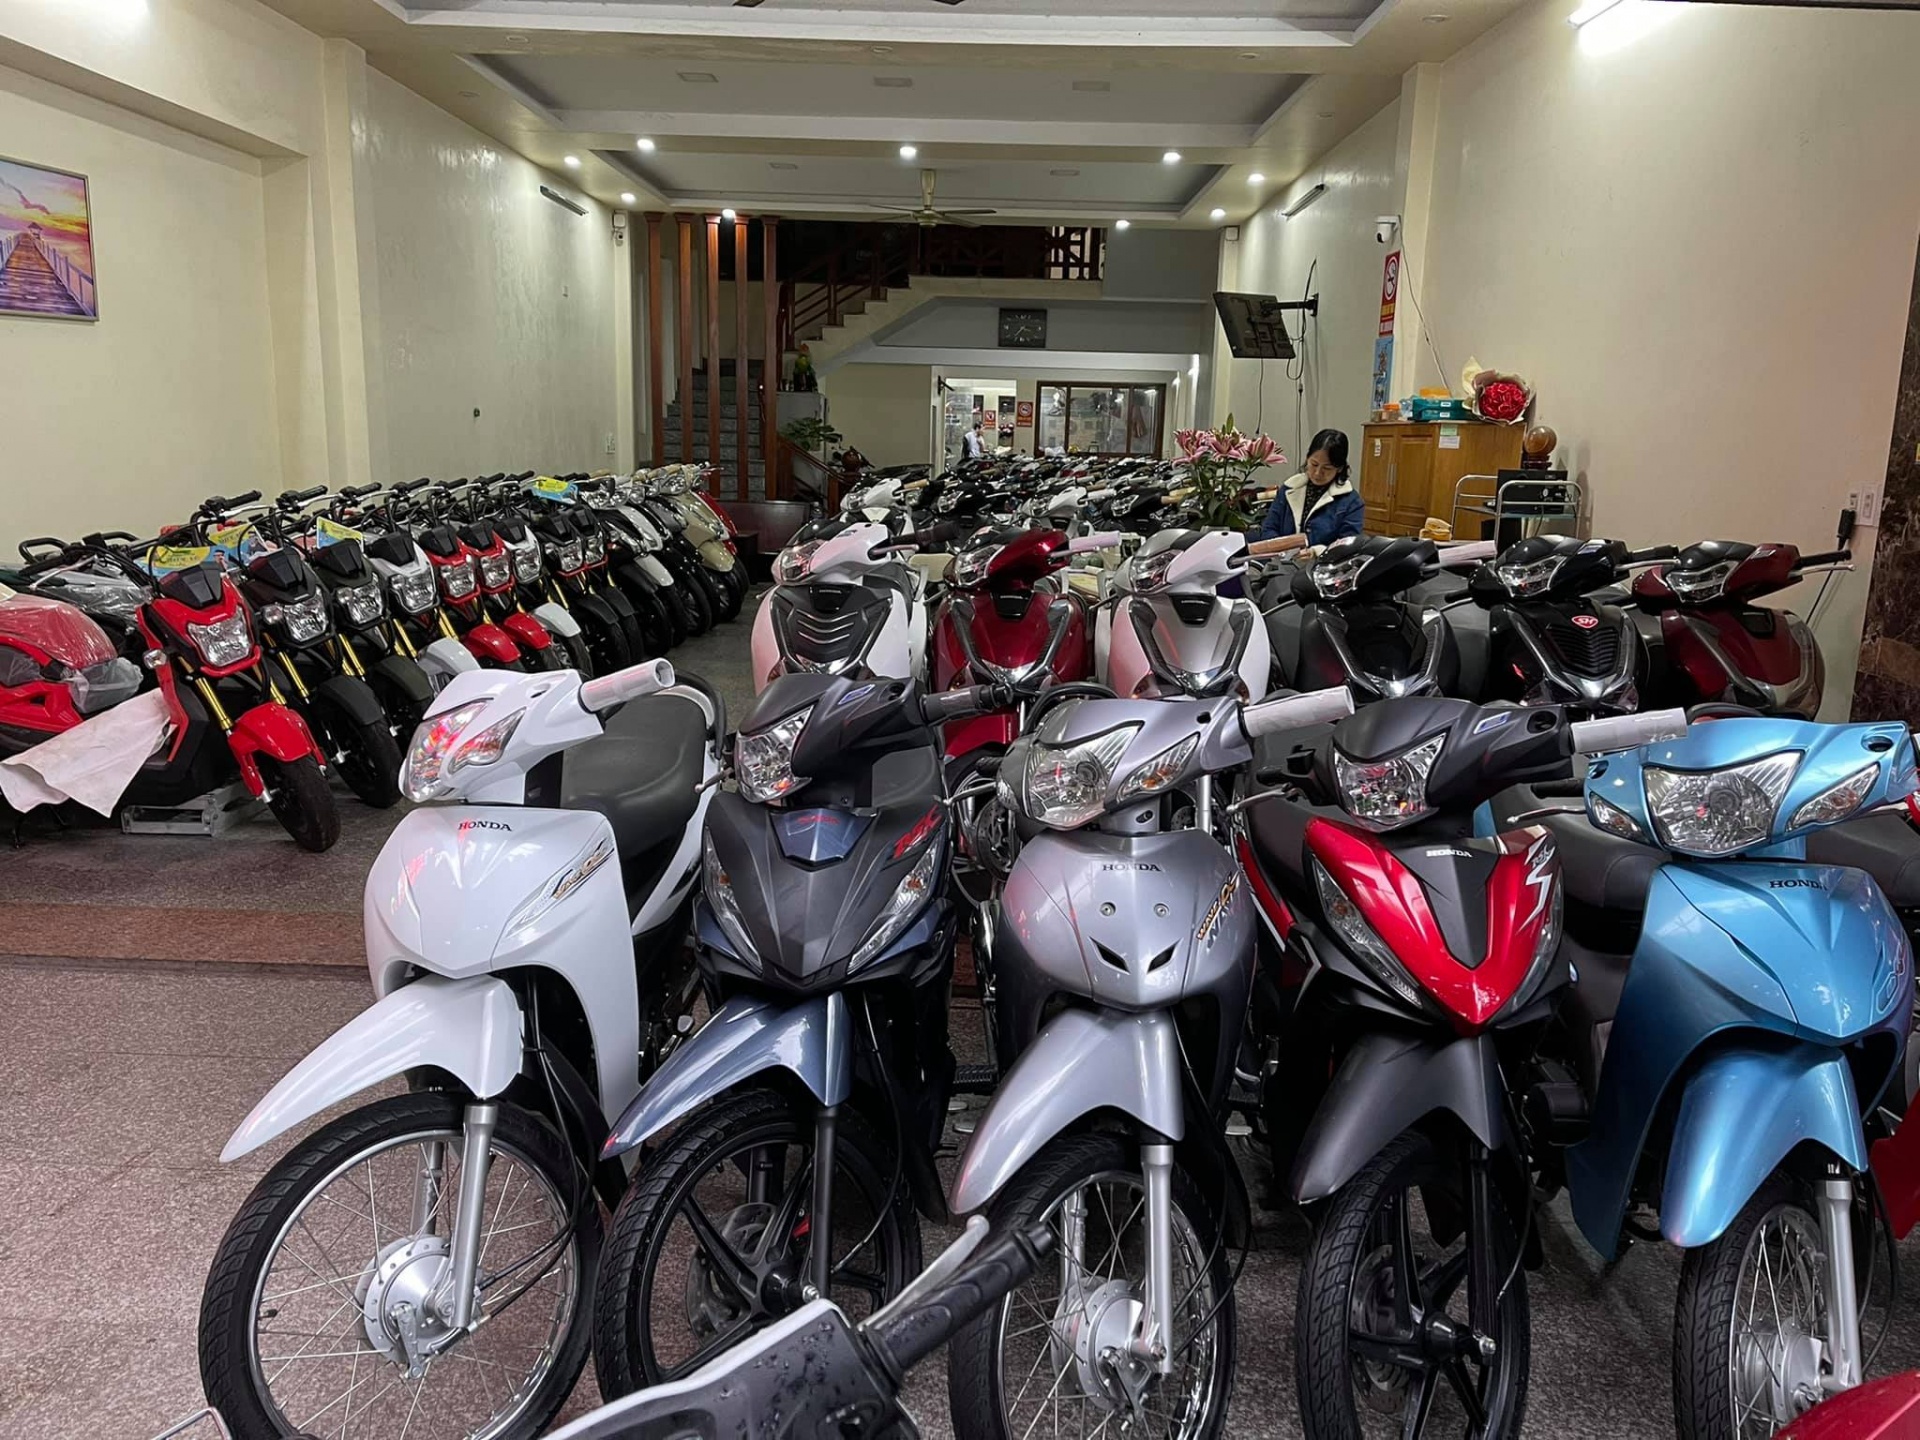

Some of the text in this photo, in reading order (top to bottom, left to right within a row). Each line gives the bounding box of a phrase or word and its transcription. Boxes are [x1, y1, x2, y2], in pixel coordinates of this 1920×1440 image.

[458, 820, 513, 832] HONDA
[1426, 848, 1473, 858] HONDA
[1102, 863, 1162, 872] HONDA
